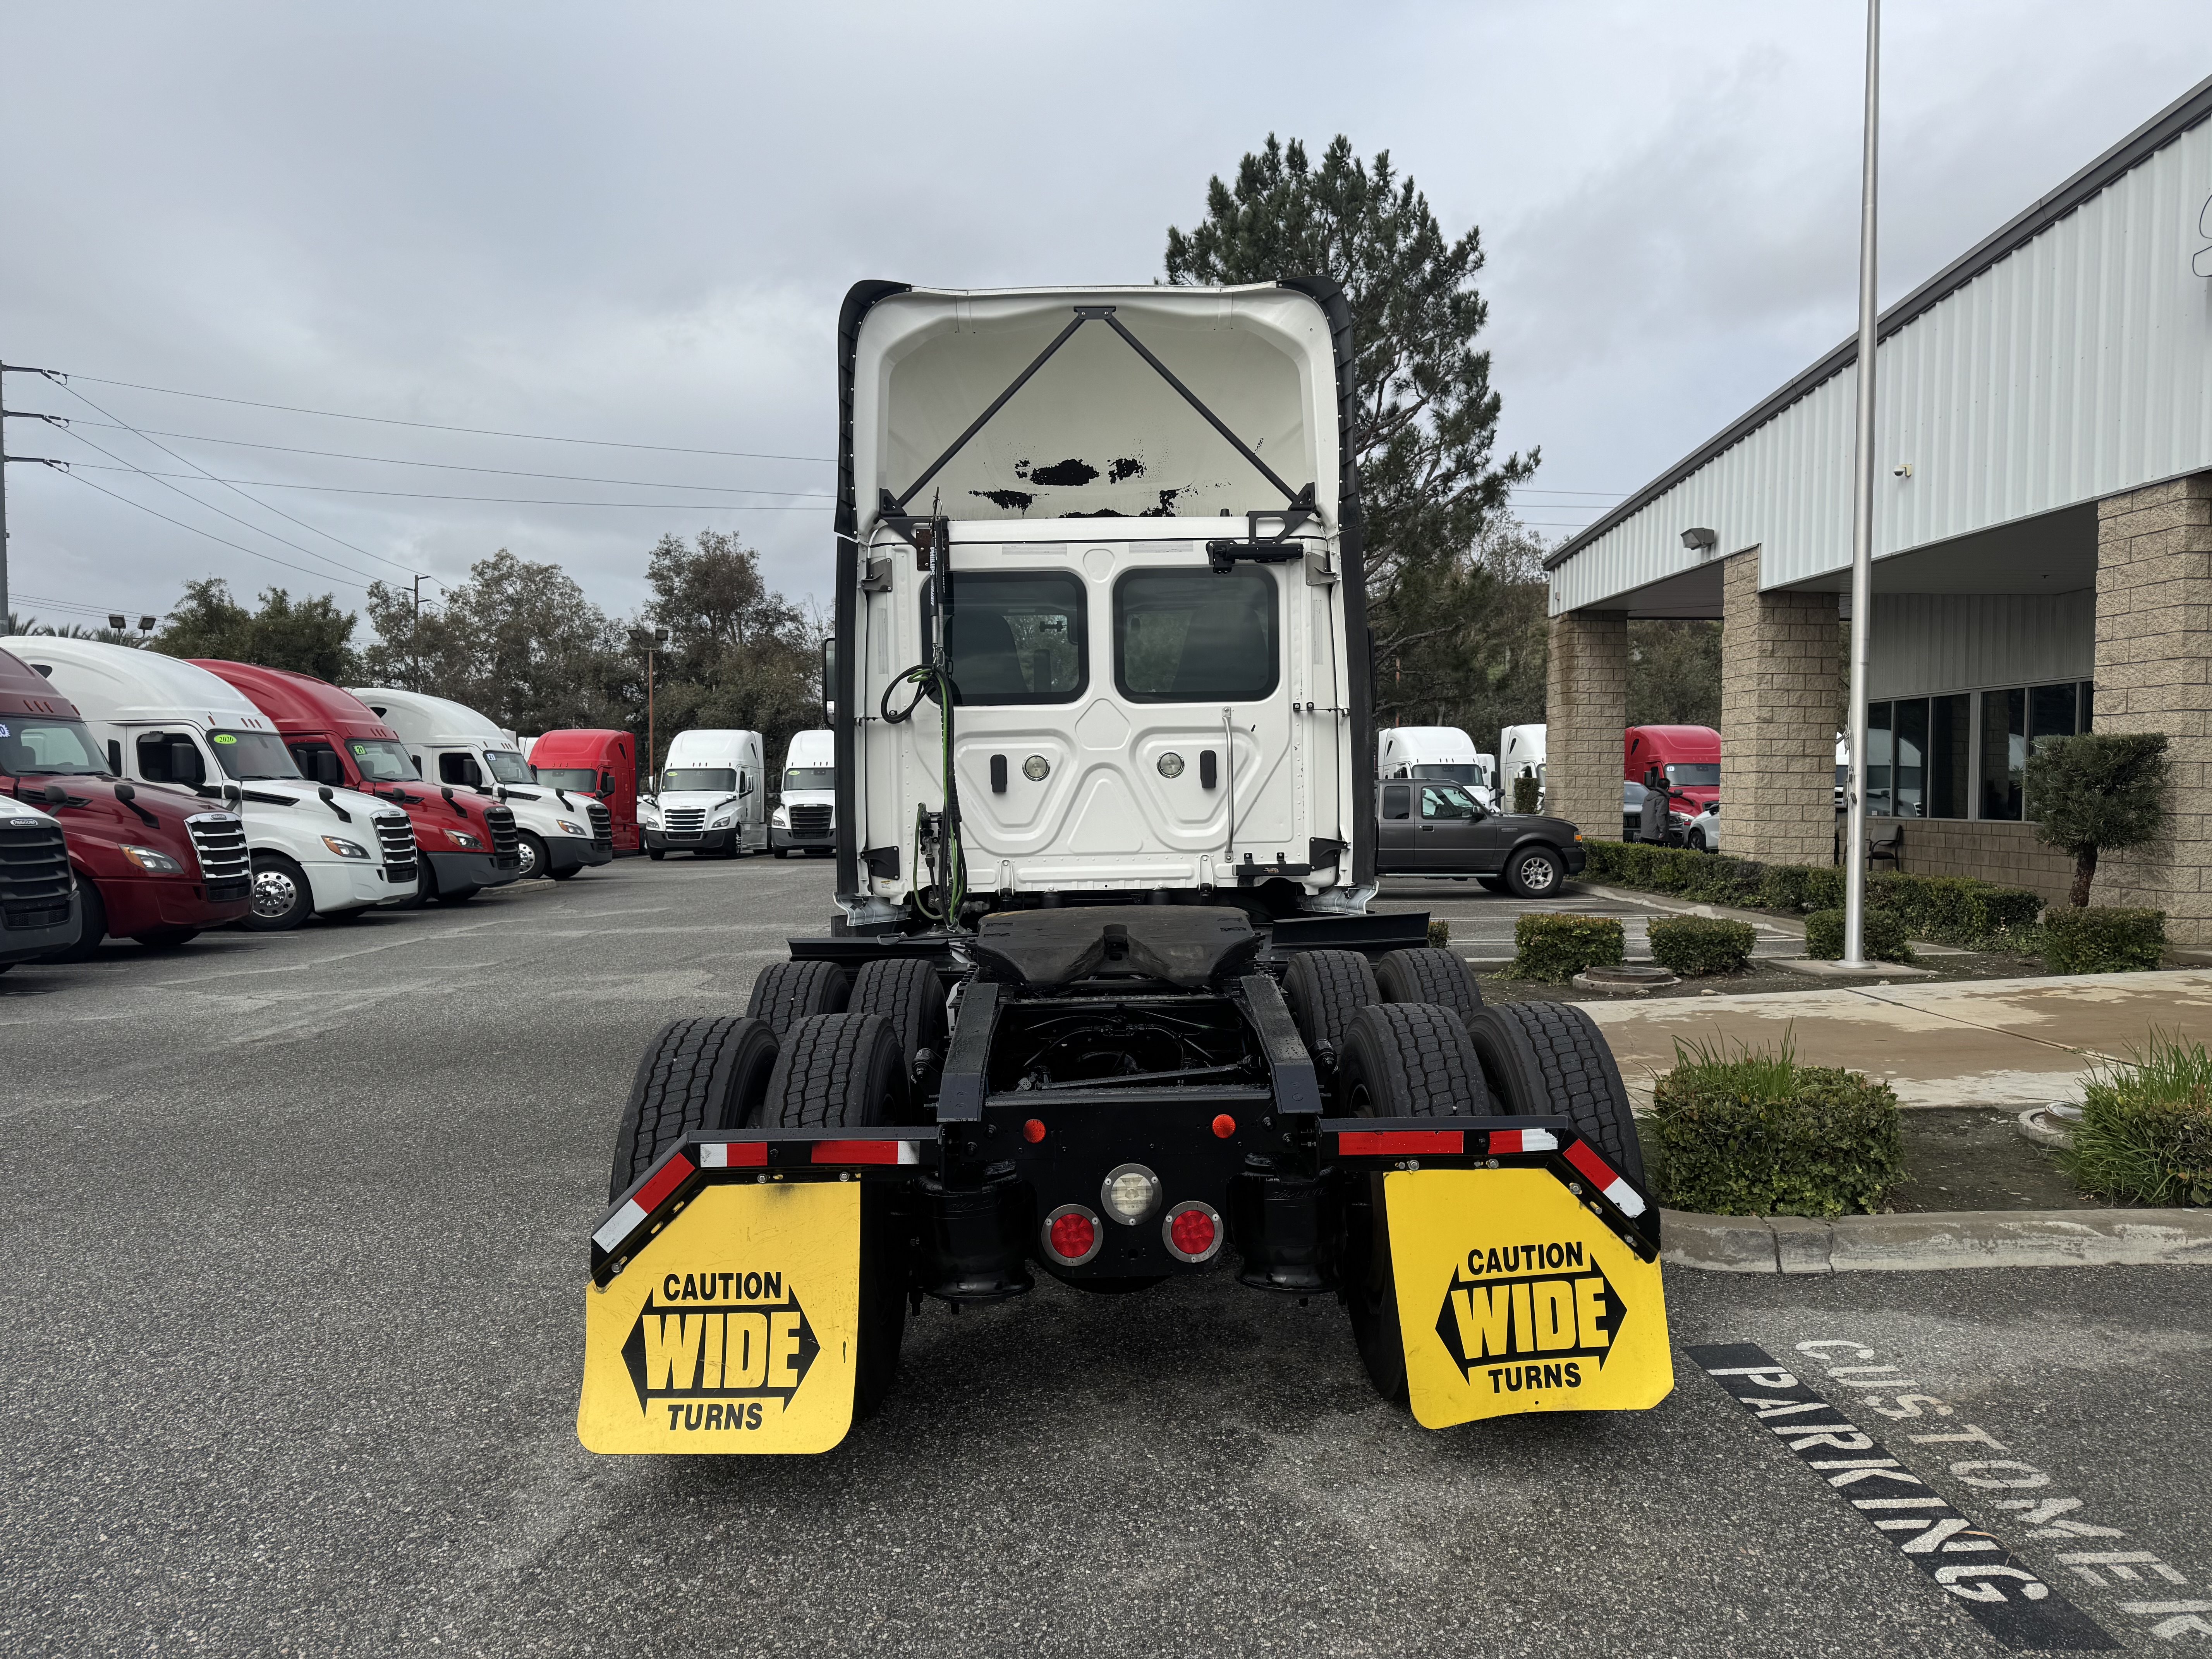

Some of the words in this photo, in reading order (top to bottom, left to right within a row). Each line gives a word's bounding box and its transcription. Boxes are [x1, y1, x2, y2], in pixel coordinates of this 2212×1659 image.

[1467, 1241, 1583, 1275] CAUTION
[663, 1272, 781, 1301] CAUTION
[1450, 1277, 1609, 1360] WIDE
[642, 1311, 800, 1389] WIDE
[1488, 1362, 1582, 1393] TURNS
[668, 1403, 763, 1431] TURNS
[1708, 1367, 2049, 1602] PARKING
